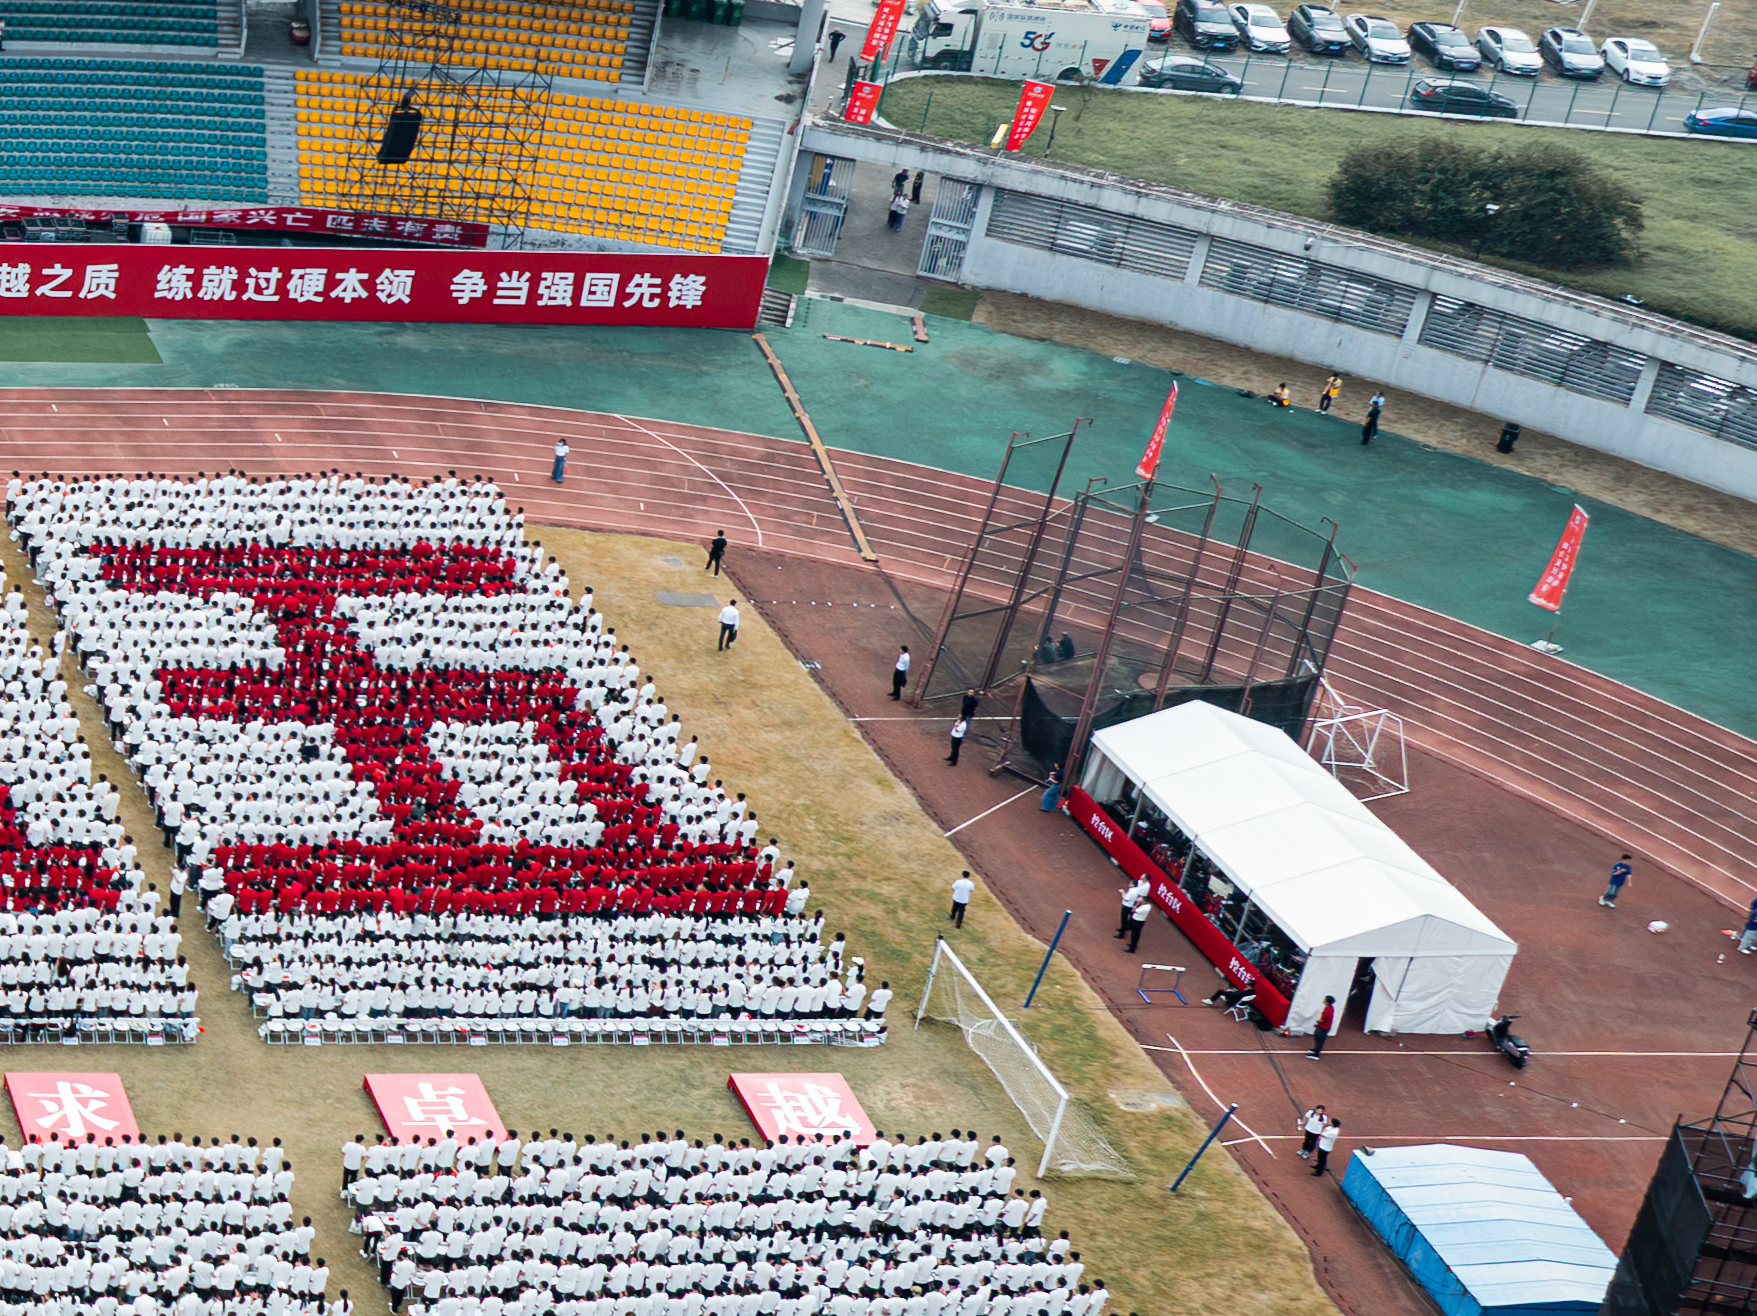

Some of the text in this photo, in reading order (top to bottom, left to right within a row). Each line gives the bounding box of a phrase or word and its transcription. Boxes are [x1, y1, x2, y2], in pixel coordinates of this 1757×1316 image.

[326, 214, 463, 240] 匹夫有责
[153, 264, 416, 305] 练就过硬本领
[449, 268, 707, 310] 争当强国先锋
[28, 1081, 117, 1136] 求
[402, 1083, 492, 1136] 卓
[763, 1087, 862, 1140] 越
